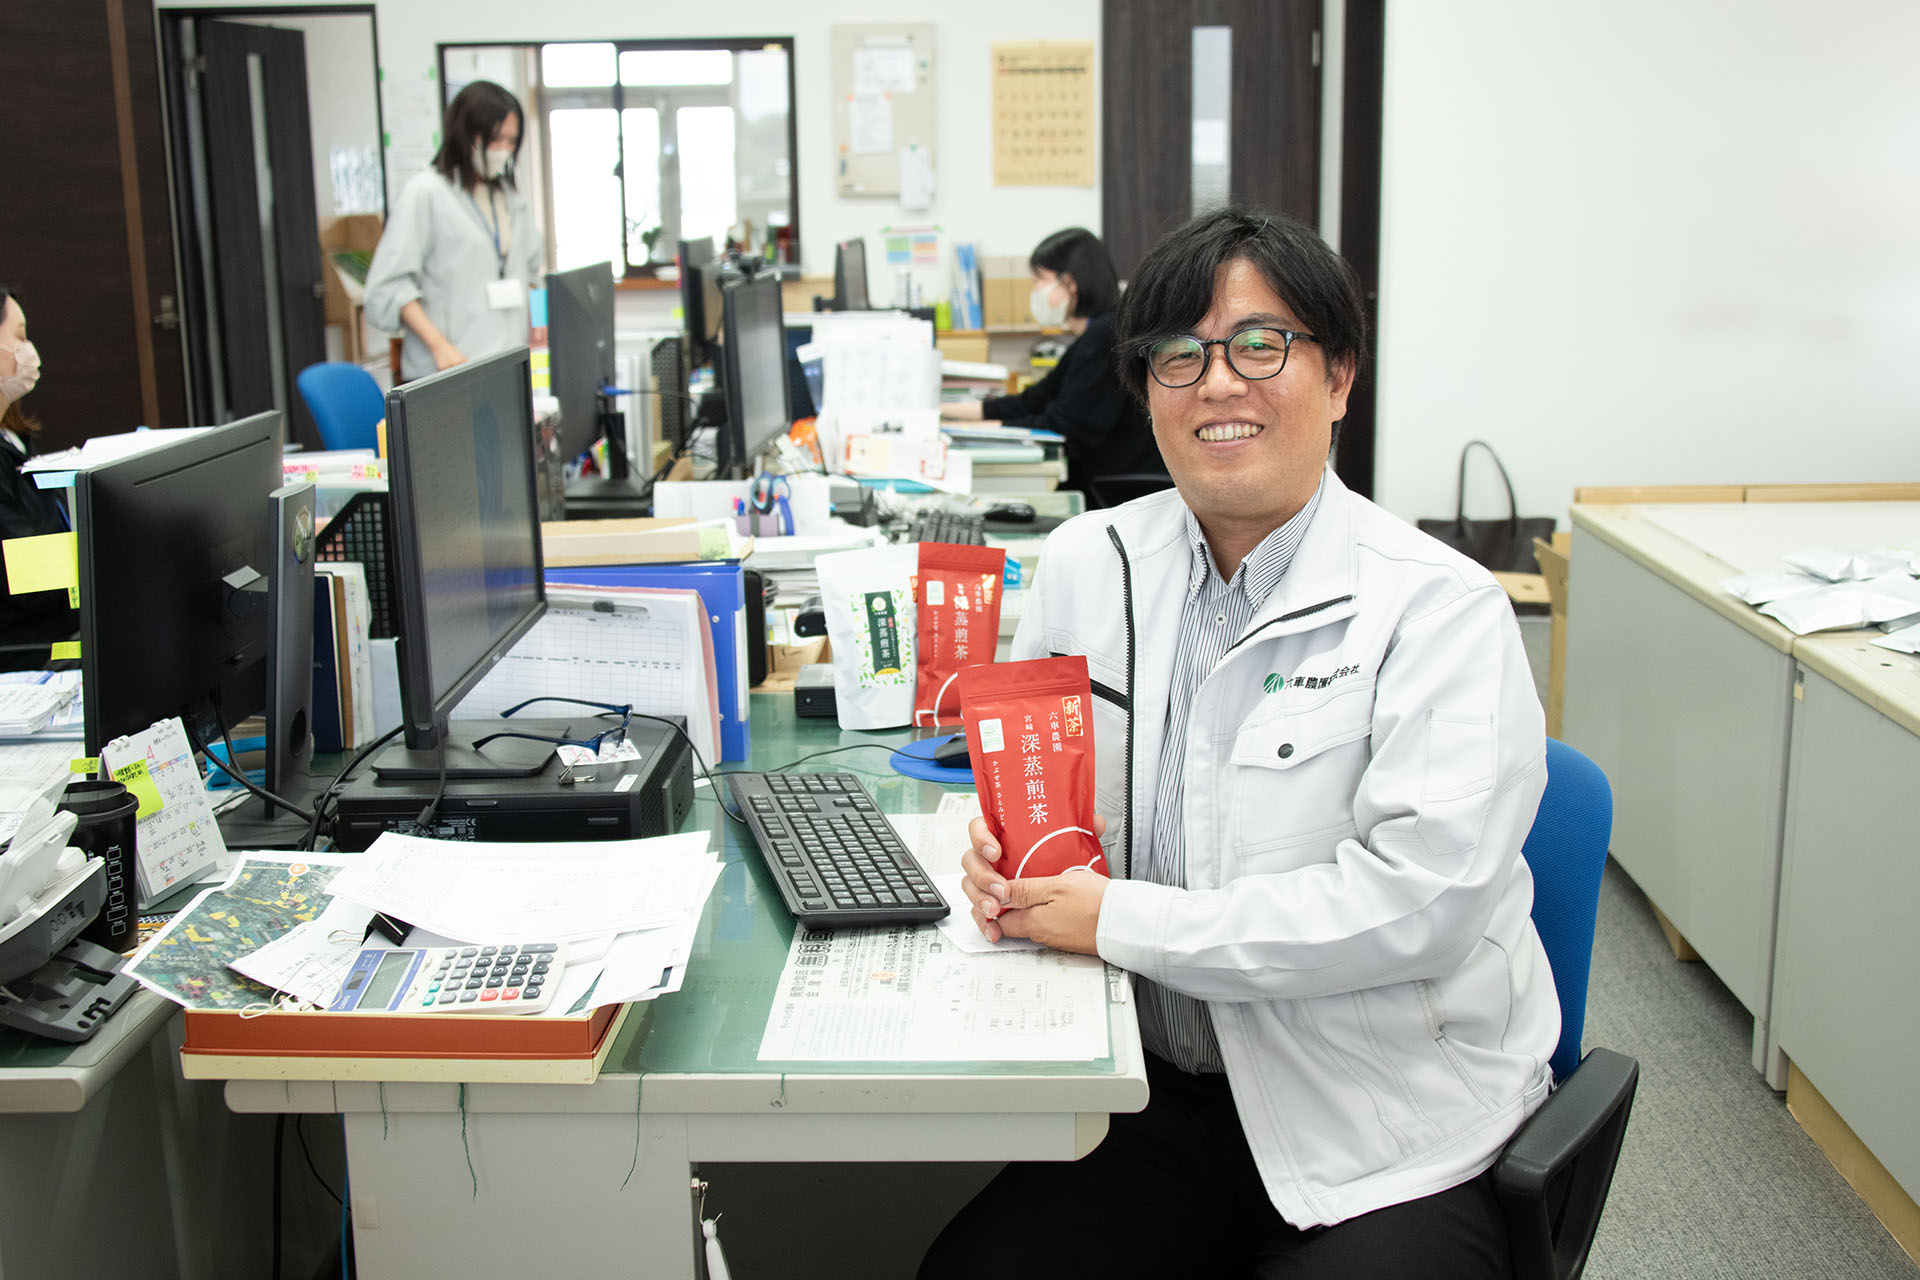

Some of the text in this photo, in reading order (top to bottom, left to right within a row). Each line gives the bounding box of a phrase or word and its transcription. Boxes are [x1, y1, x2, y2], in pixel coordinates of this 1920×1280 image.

[1283, 663, 1360, 690] 六車農園会社
[1023, 714, 1034, 731] 宮崎
[1048, 711, 1063, 753] 六車農園
[1065, 699, 1081, 733] 新茶
[1020, 733, 1049, 825] 深蒸煎茶
[795, 928, 835, 967] 無料回
